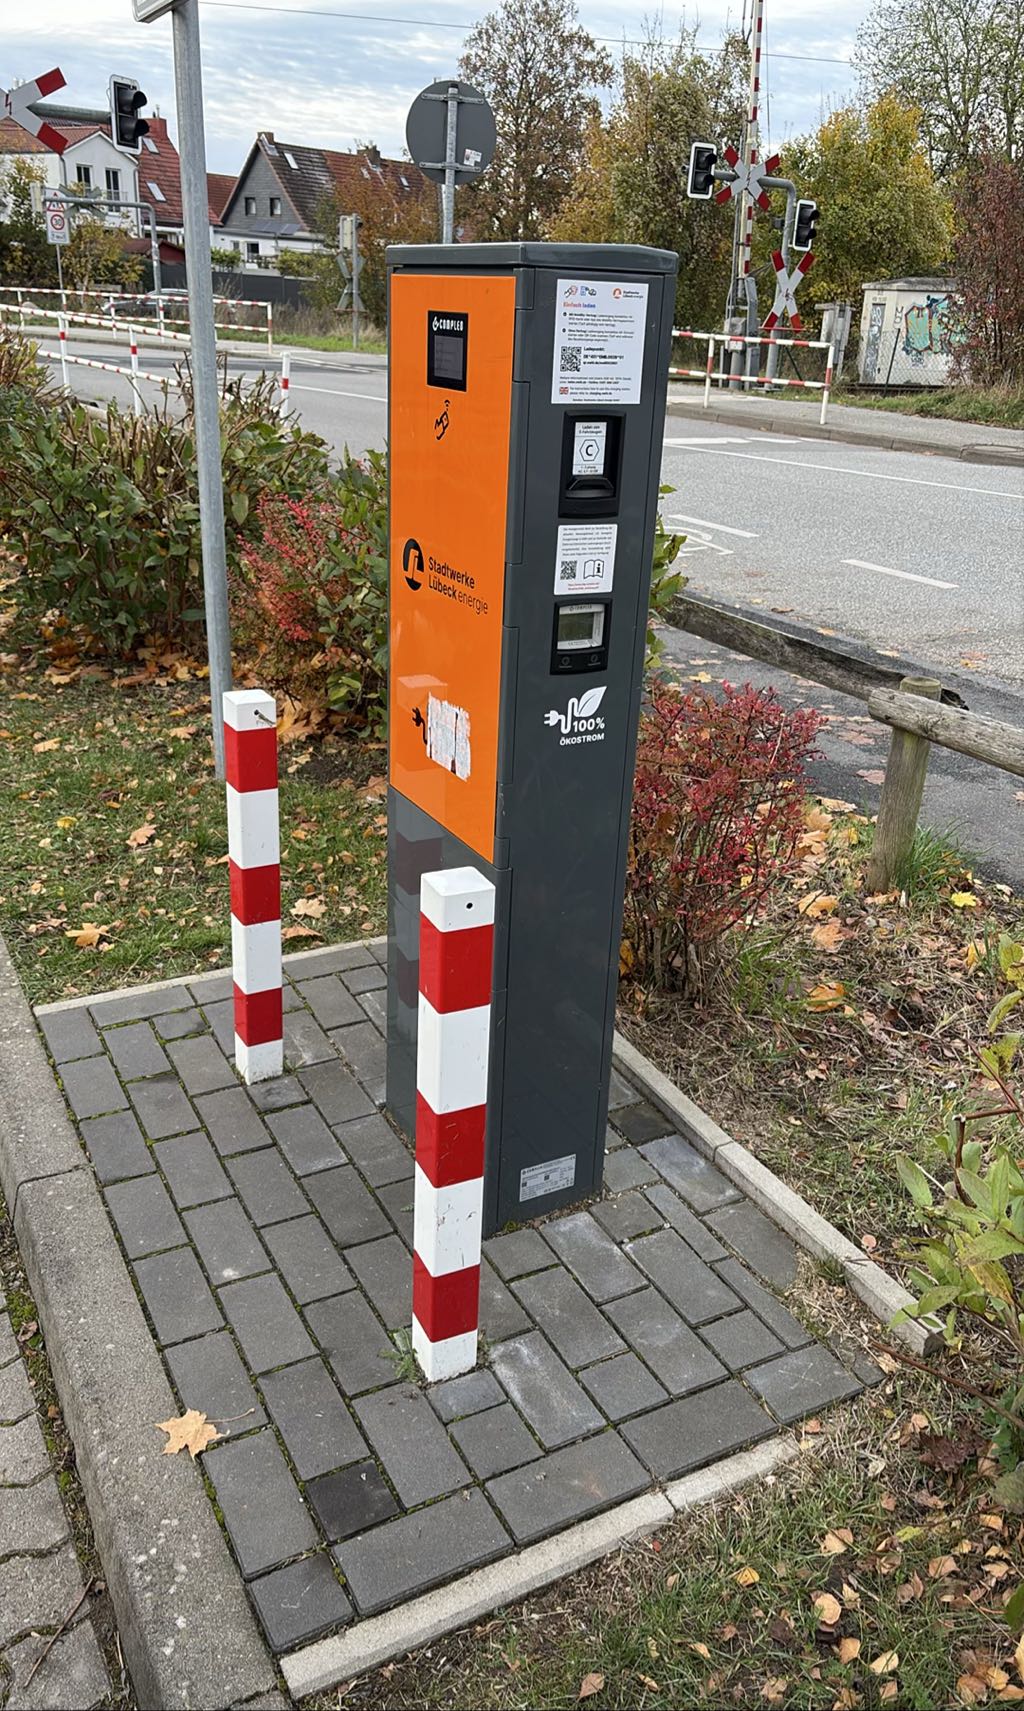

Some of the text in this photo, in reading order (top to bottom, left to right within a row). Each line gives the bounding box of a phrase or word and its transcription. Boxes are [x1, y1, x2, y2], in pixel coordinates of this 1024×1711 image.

[585, 444, 594, 457] C
[428, 556, 475, 590] Stadtwerke
[572, 716, 606, 733] 100%
[559, 732, 605, 746] ÖKOSTROM
